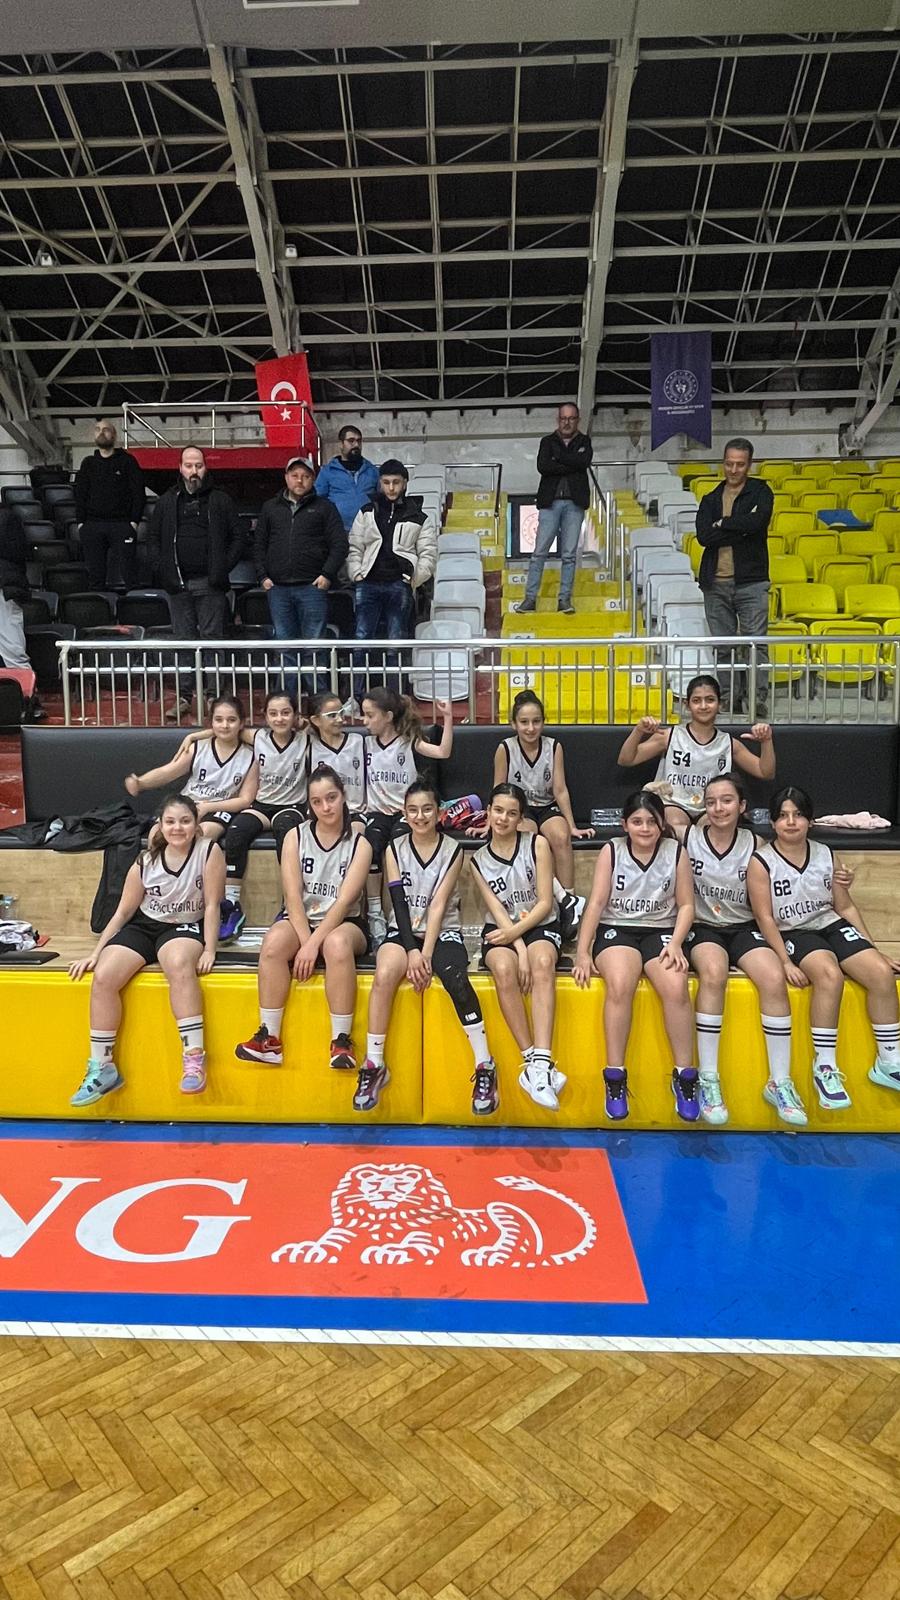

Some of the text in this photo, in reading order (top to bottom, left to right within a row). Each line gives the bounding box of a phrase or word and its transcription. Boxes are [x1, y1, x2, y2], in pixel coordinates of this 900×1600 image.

[672, 750, 691, 767] 54
[199, 768, 207, 781] 8
[514, 770, 522, 782] 4
[488, 876, 507, 895] 28
[616, 874, 625, 891] 5
[774, 879, 792, 897] 62
